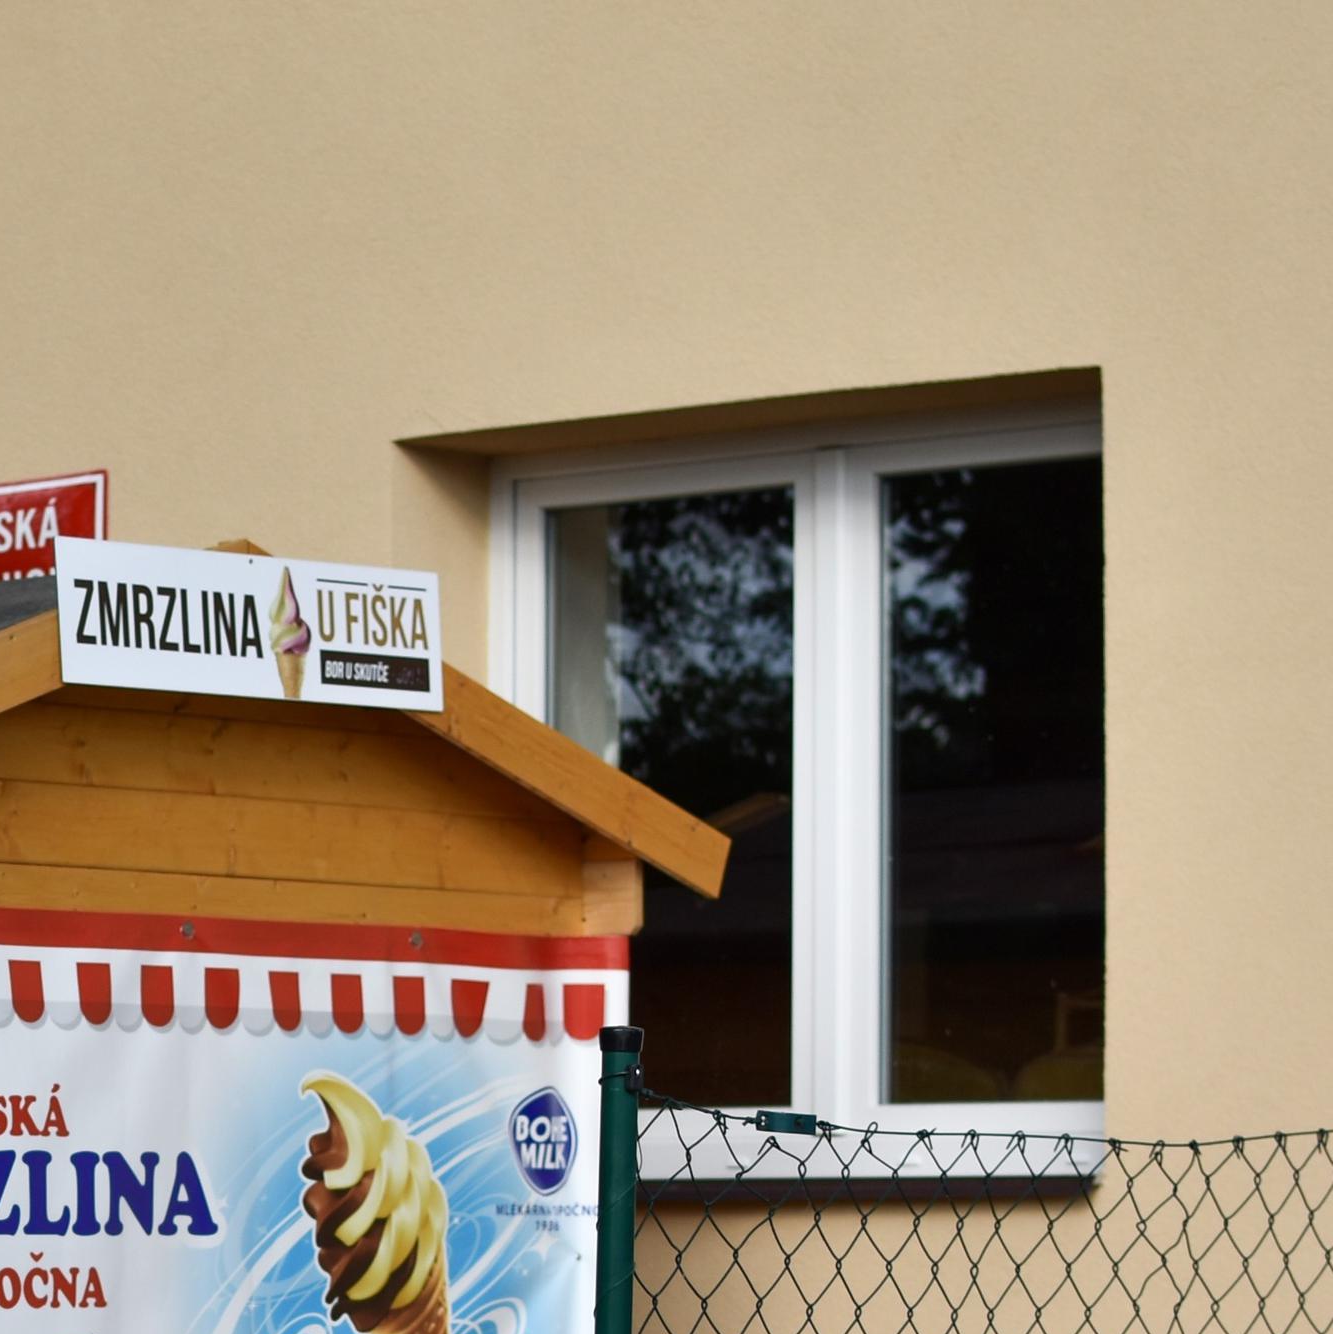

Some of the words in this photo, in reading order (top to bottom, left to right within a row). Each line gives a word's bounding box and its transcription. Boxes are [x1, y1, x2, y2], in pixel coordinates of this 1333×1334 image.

[74, 579, 264, 659] ZMRZLINA
[317, 589, 335, 643] U
[344, 583, 429, 651] FIŠKA
[324, 660, 344, 679] BOR
[345, 661, 353, 680] U
[354, 662, 389, 683] SKUTČE
[520, 1143, 566, 1169] MILK
